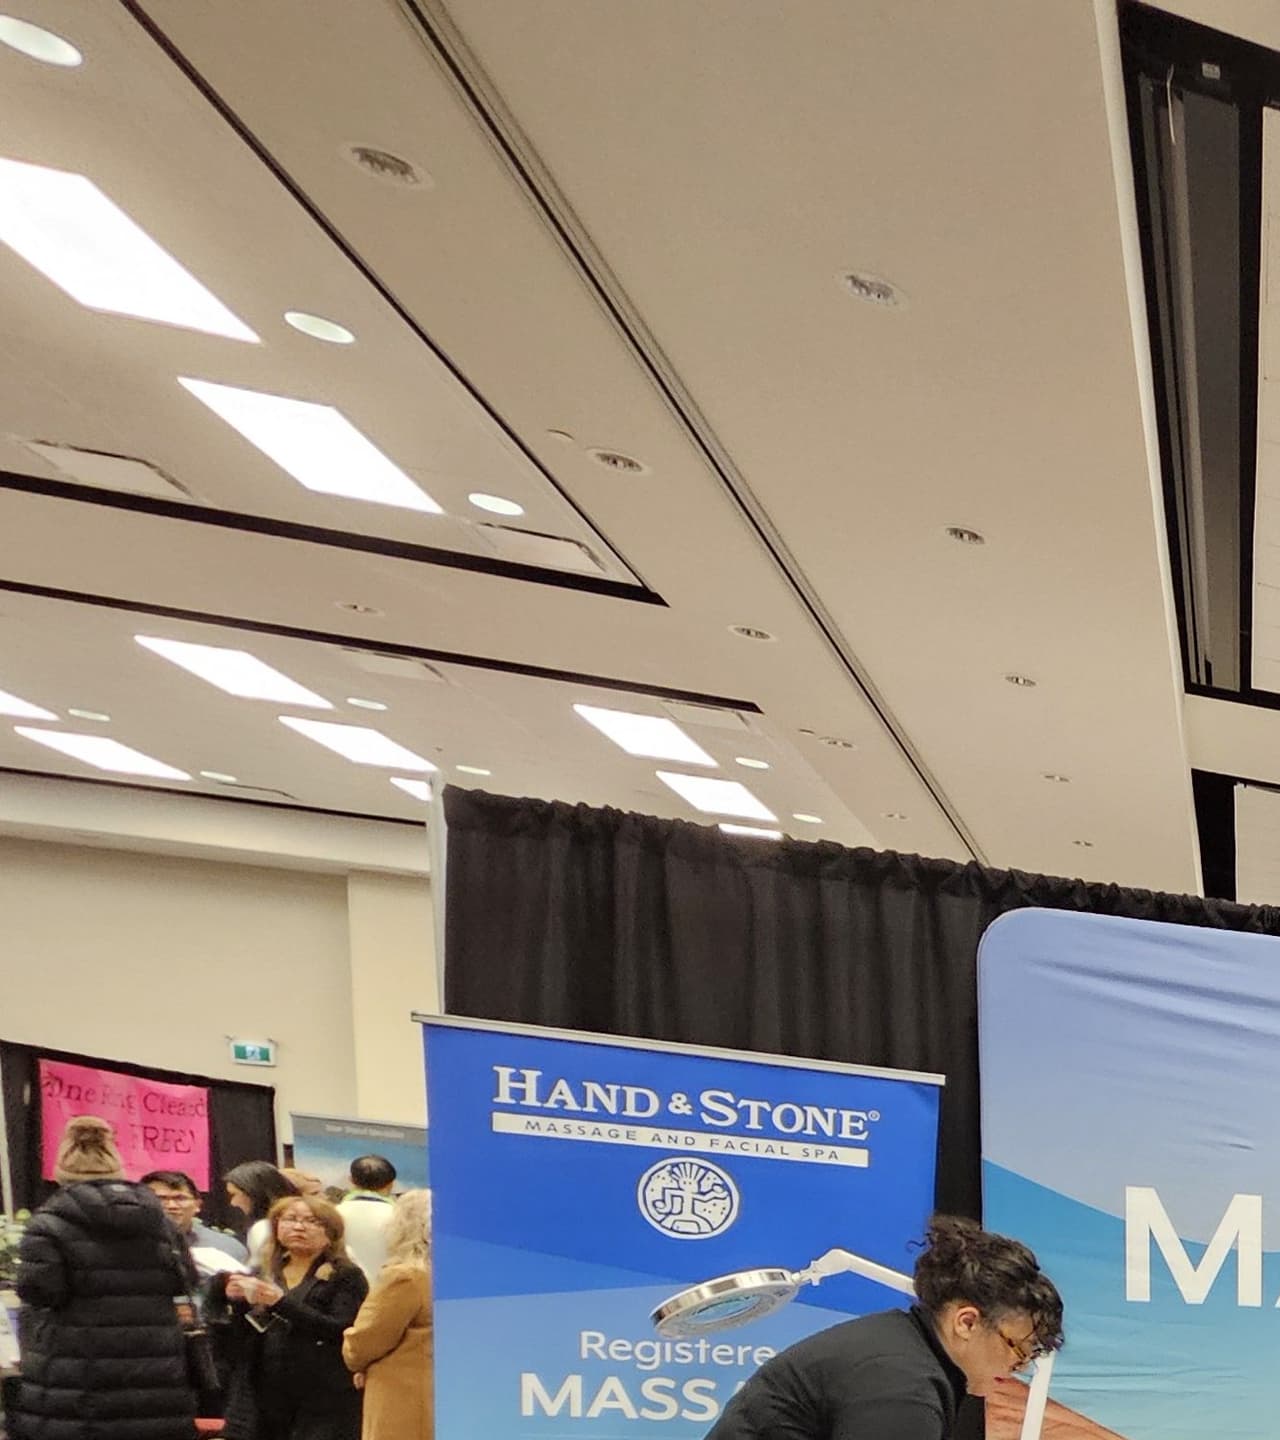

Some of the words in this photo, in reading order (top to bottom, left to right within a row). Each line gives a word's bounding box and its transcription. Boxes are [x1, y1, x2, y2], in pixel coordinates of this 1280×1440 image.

[493, 1065, 660, 1118] HAND
[668, 1092, 693, 1116] &
[525, 1120, 637, 1141] MASSAGE
[651, 1132, 696, 1146] AND
[709, 1137, 790, 1156] FACIAL
[802, 1147, 839, 1161] SPA
[521, 1372, 746, 1421] MASS
